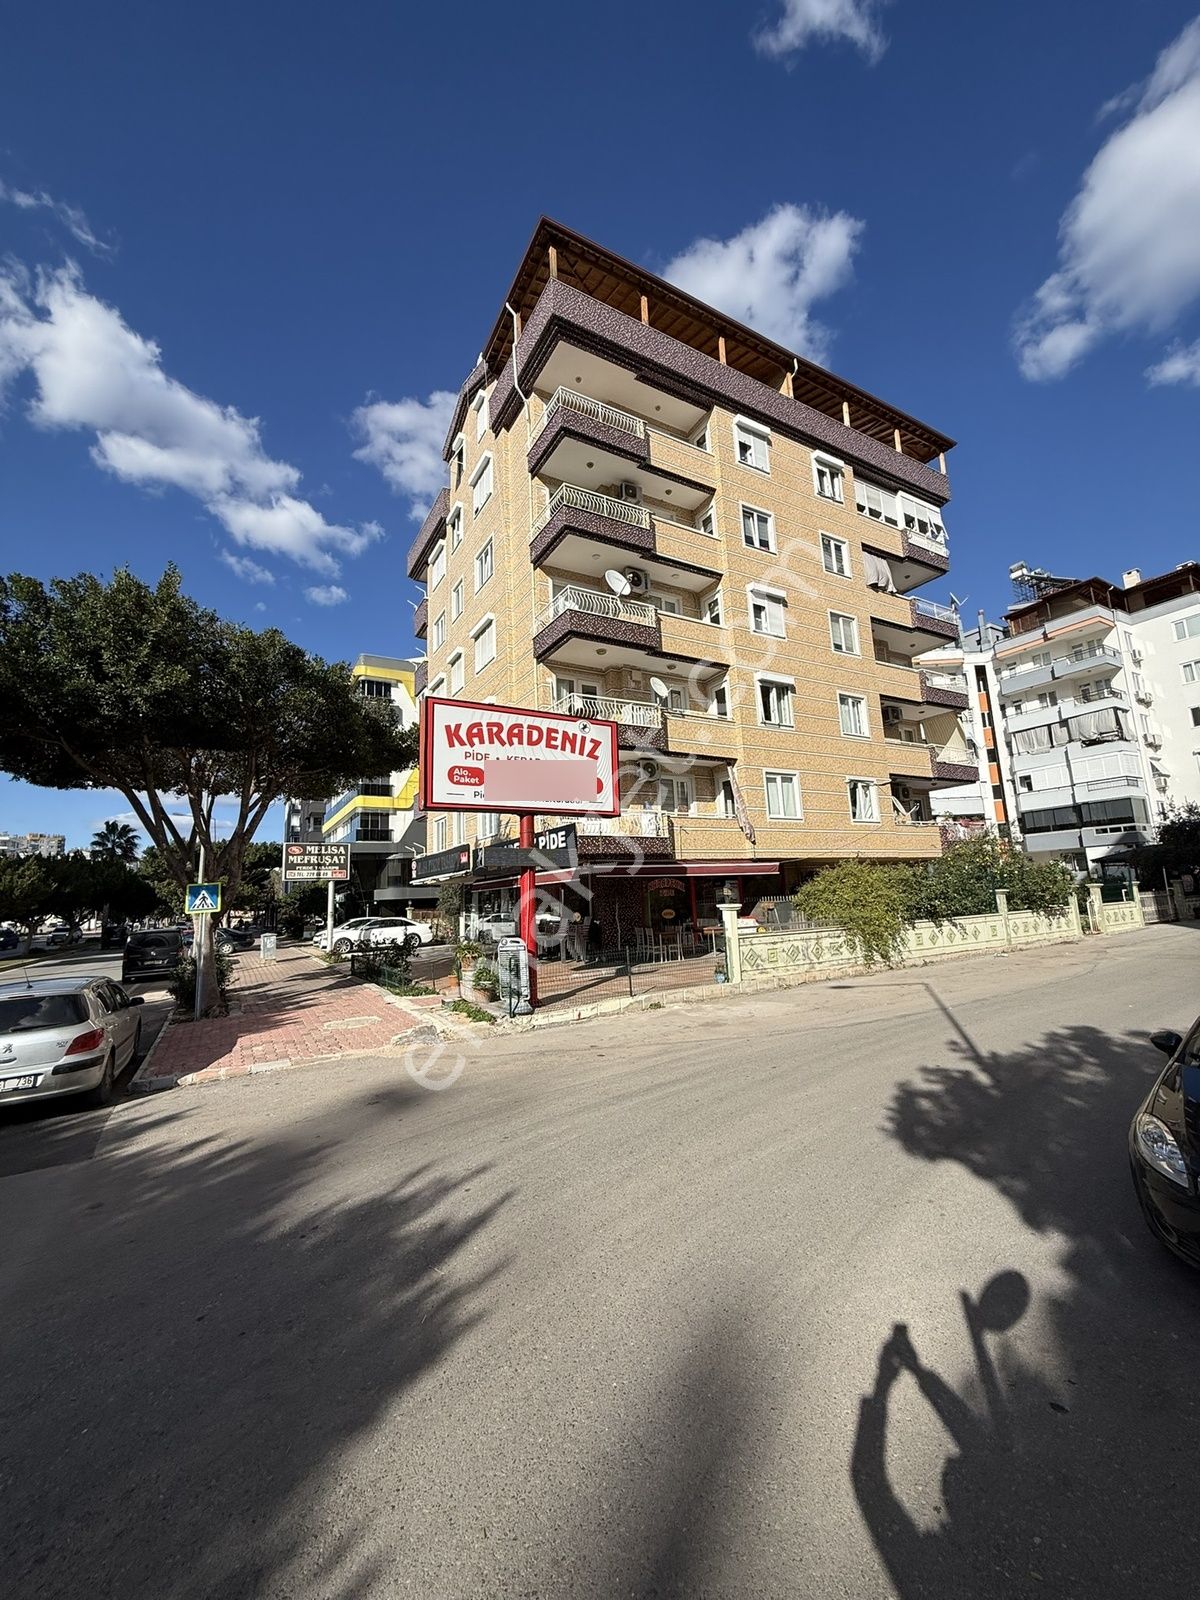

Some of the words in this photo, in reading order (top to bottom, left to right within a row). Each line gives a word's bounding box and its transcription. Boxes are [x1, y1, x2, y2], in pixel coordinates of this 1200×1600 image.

[453, 776, 480, 784] Paket
[538, 831, 567, 850] PİDE
[306, 845, 346, 854] MELİSA
[288, 855, 346, 866] MEFRUŞAT
